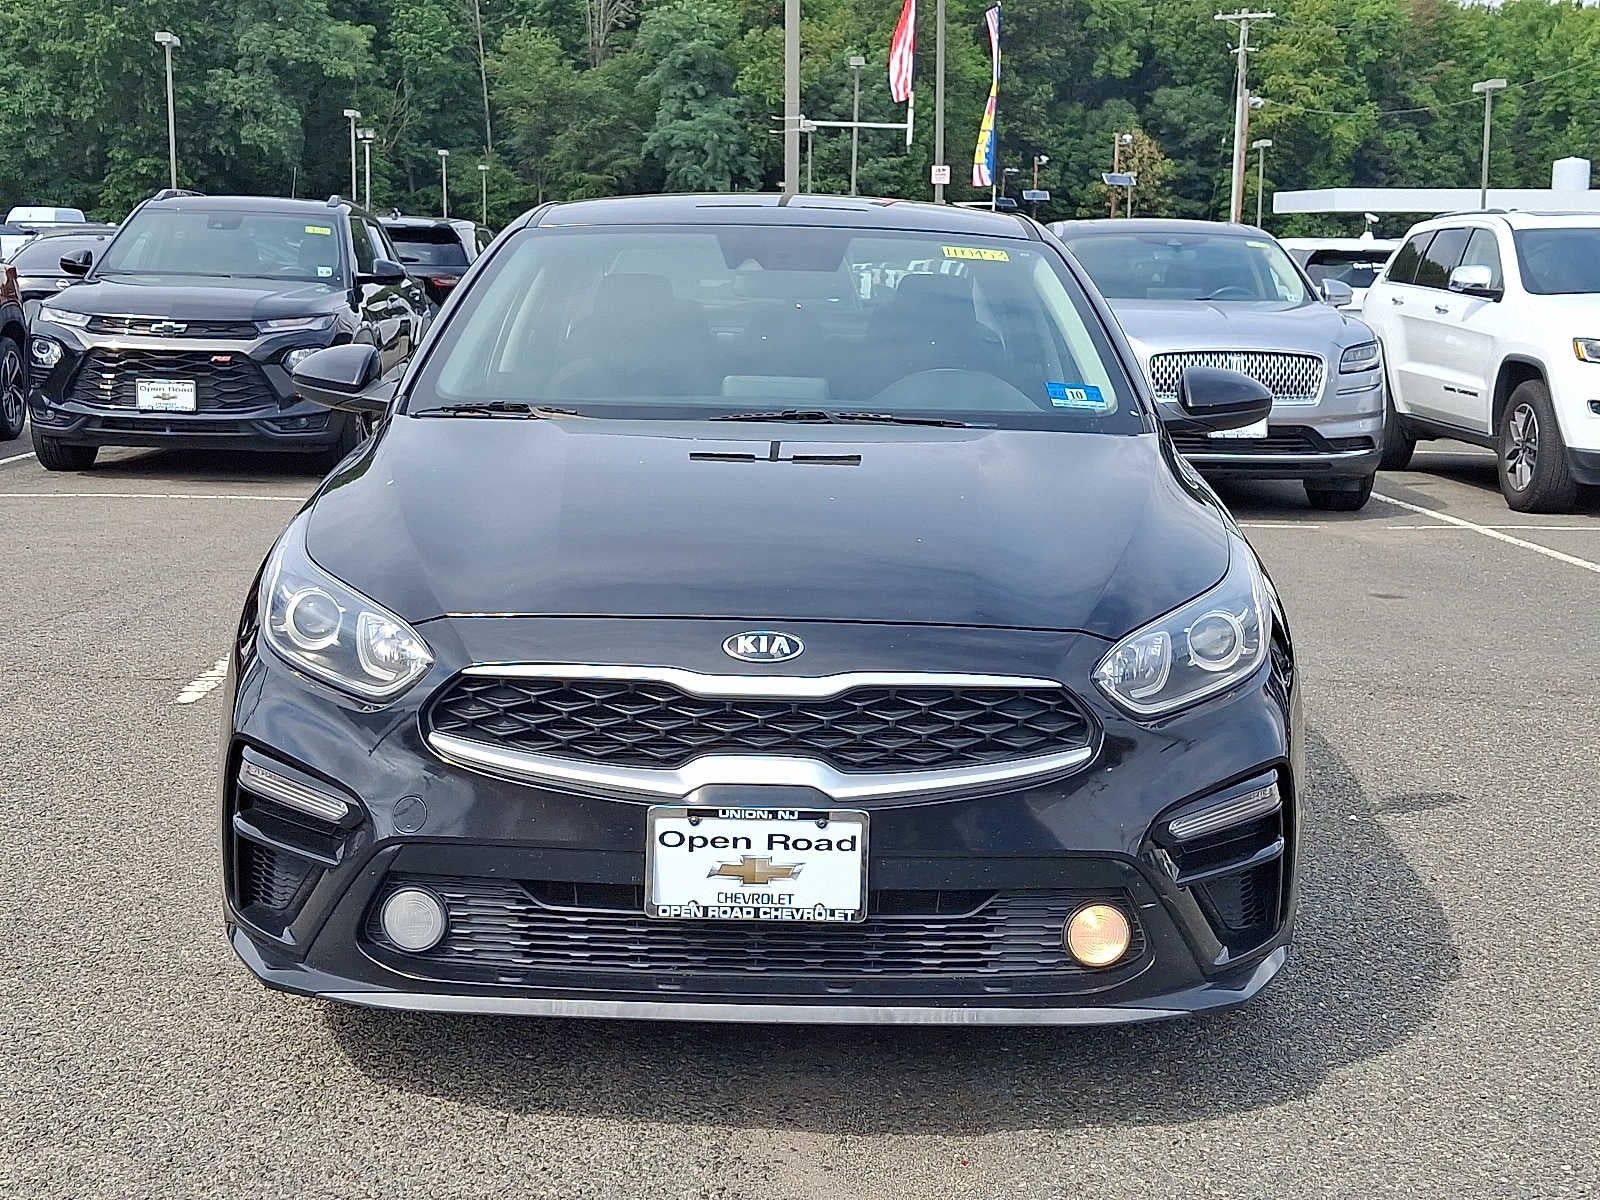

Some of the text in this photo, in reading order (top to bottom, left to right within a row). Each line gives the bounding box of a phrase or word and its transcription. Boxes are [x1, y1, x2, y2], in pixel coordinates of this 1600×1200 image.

[1069, 390, 1084, 400] 10
[737, 635, 791, 654] KIA
[718, 809, 799, 820] UNION, NJ
[658, 830, 857, 852] Open Road
[717, 892, 795, 905] CHEVROLET
[658, 905, 855, 921] OPEN ROAD CHEVROLET
